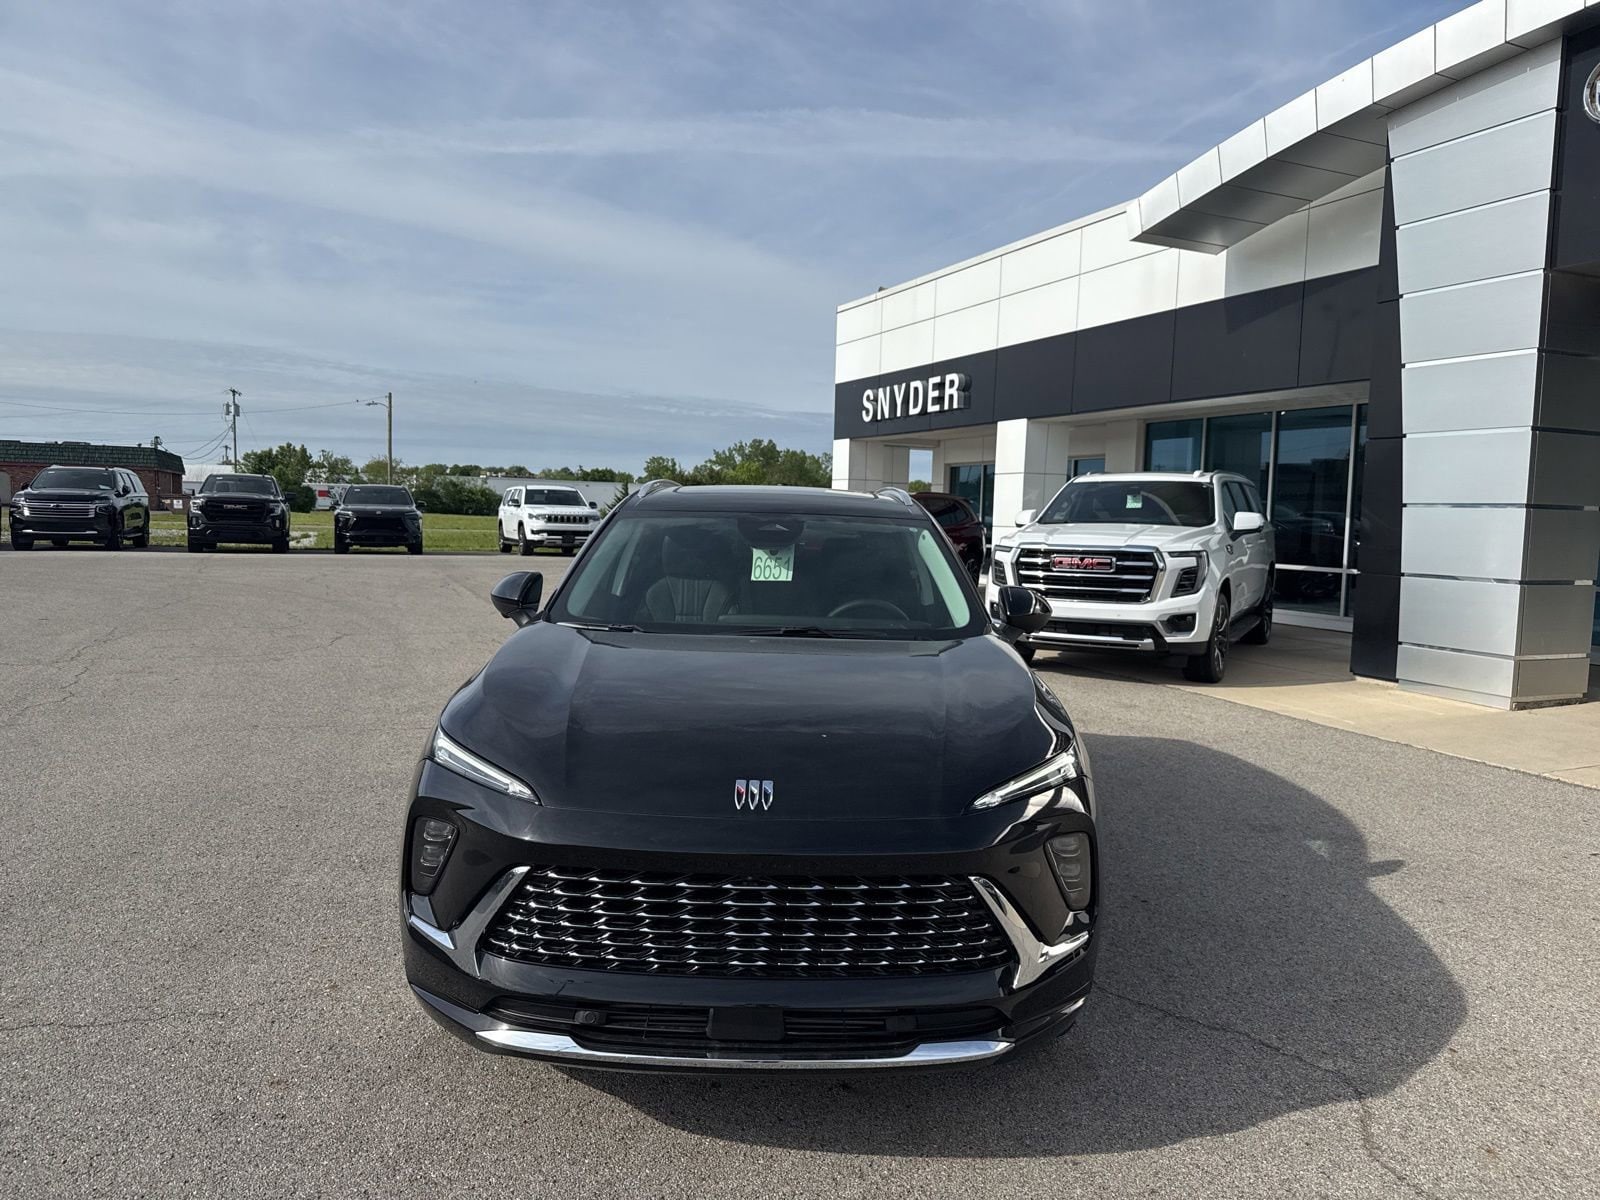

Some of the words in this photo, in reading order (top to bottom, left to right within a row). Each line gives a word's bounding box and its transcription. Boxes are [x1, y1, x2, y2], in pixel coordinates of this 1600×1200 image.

[862, 373, 960, 423] SNYDER
[753, 556, 791, 580] 6651
[1054, 556, 1111, 570] GMC
